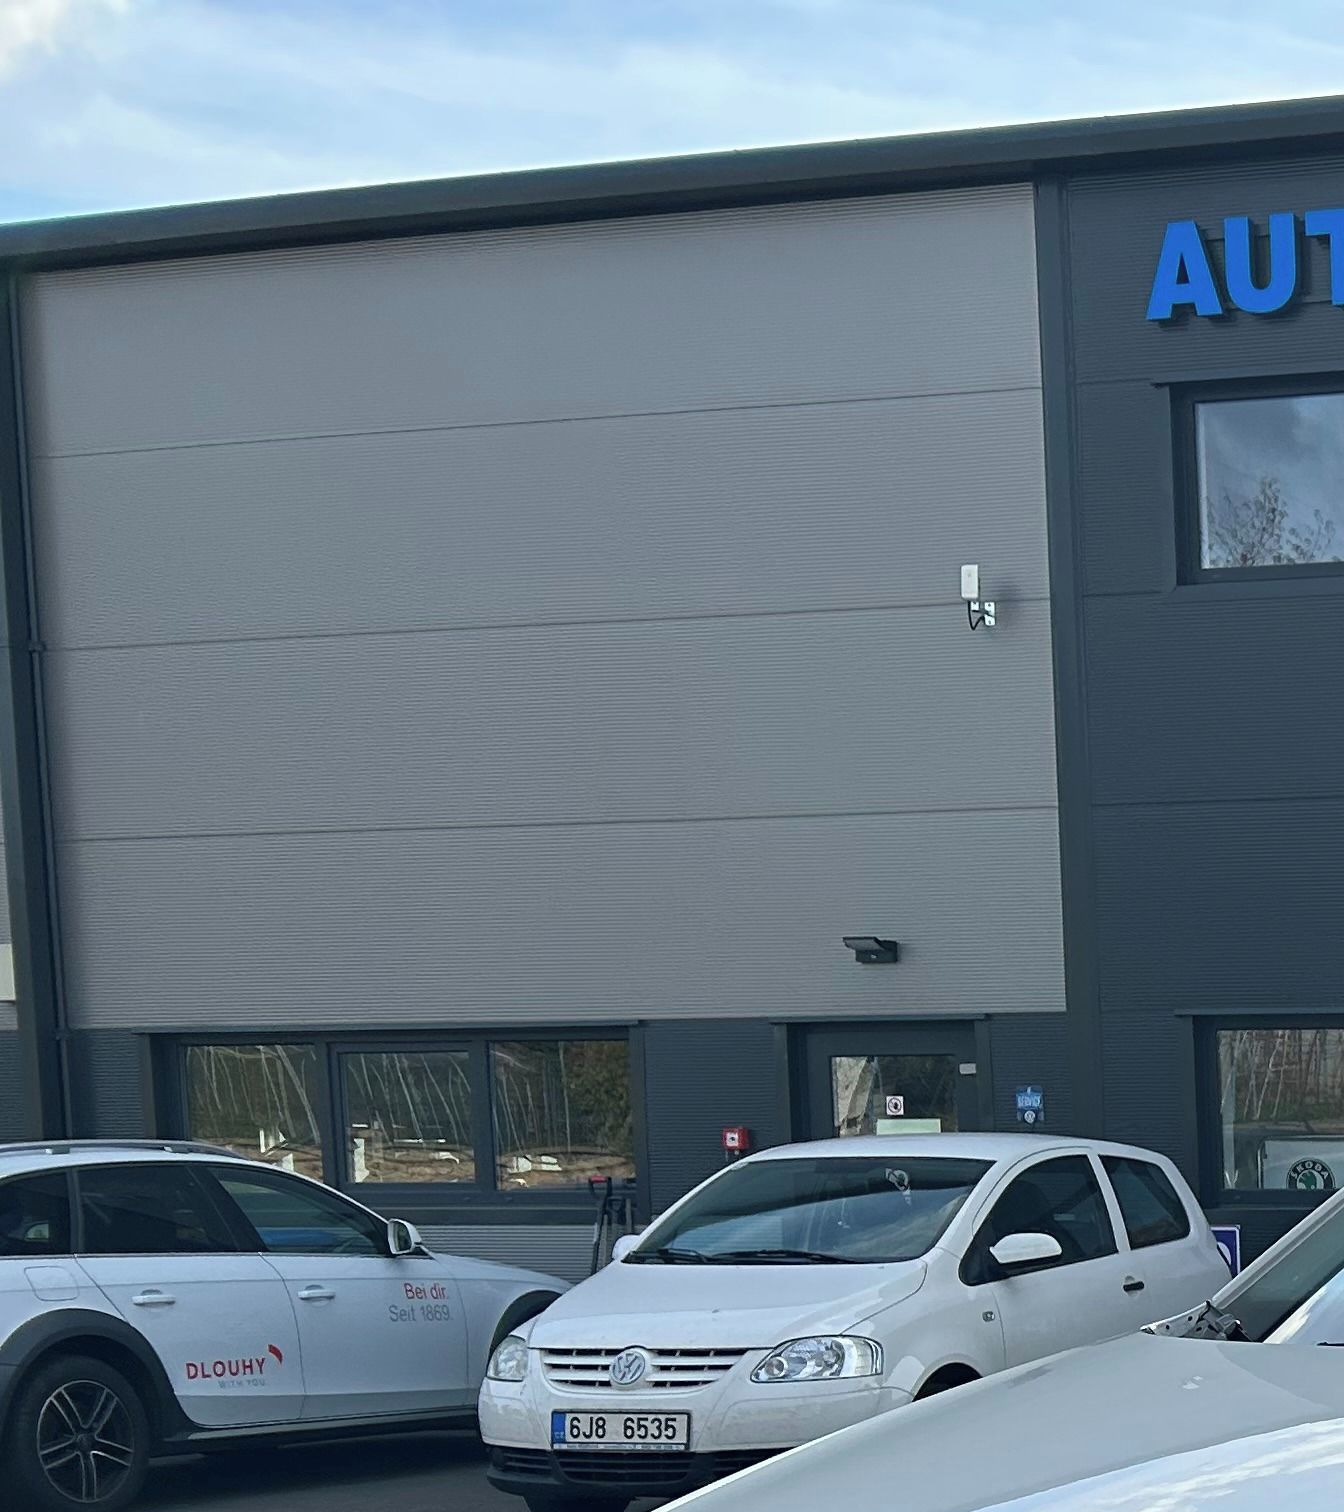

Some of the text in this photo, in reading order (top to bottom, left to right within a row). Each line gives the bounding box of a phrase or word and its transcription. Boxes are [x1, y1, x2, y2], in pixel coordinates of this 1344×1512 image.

[403, 1282, 428, 1300] Bei
[388, 1304, 417, 1322] Seit
[185, 1357, 266, 1380] DLOUHY
[569, 1416, 677, 1440] 6J8 6535
